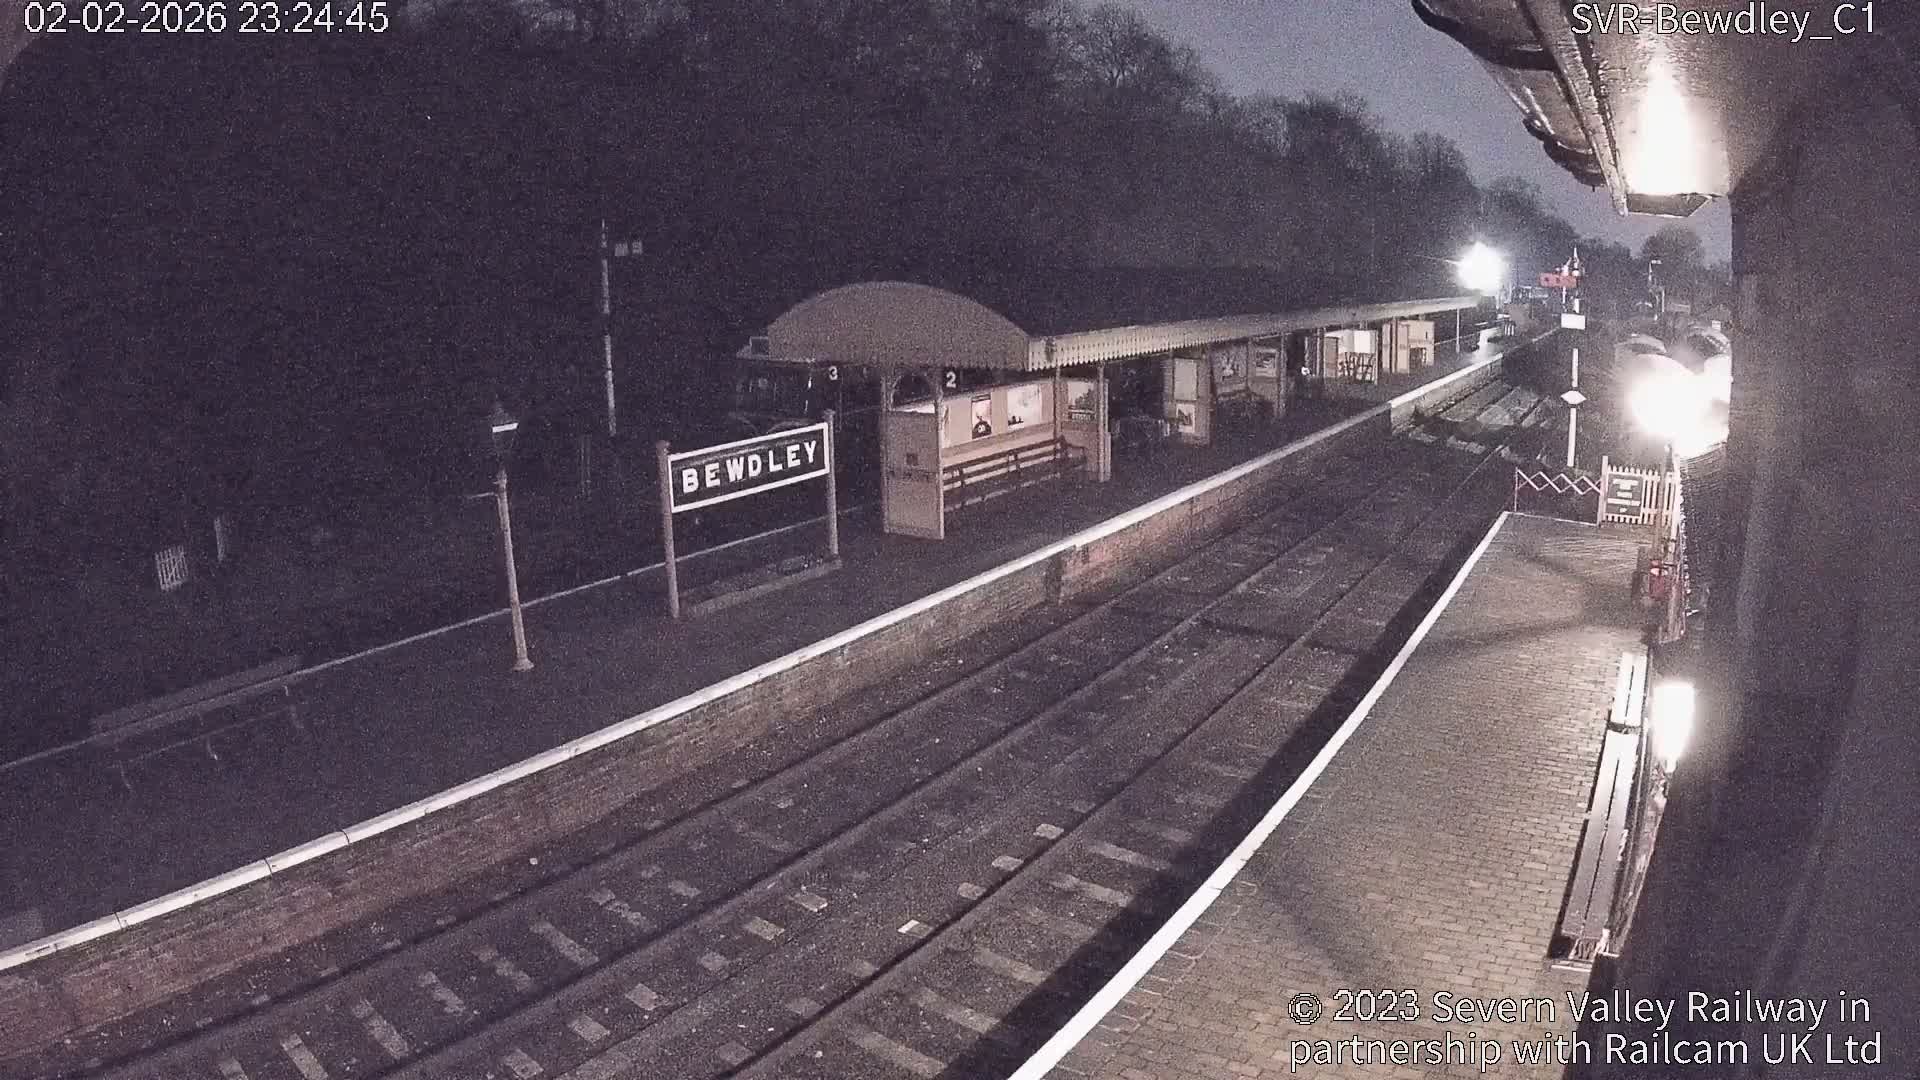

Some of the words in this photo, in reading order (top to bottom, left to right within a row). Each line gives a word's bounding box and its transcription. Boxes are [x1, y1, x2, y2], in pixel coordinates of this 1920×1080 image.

[828, 365, 838, 381] 3
[946, 371, 957, 388] 2
[682, 440, 816, 494] BEWDLEY
